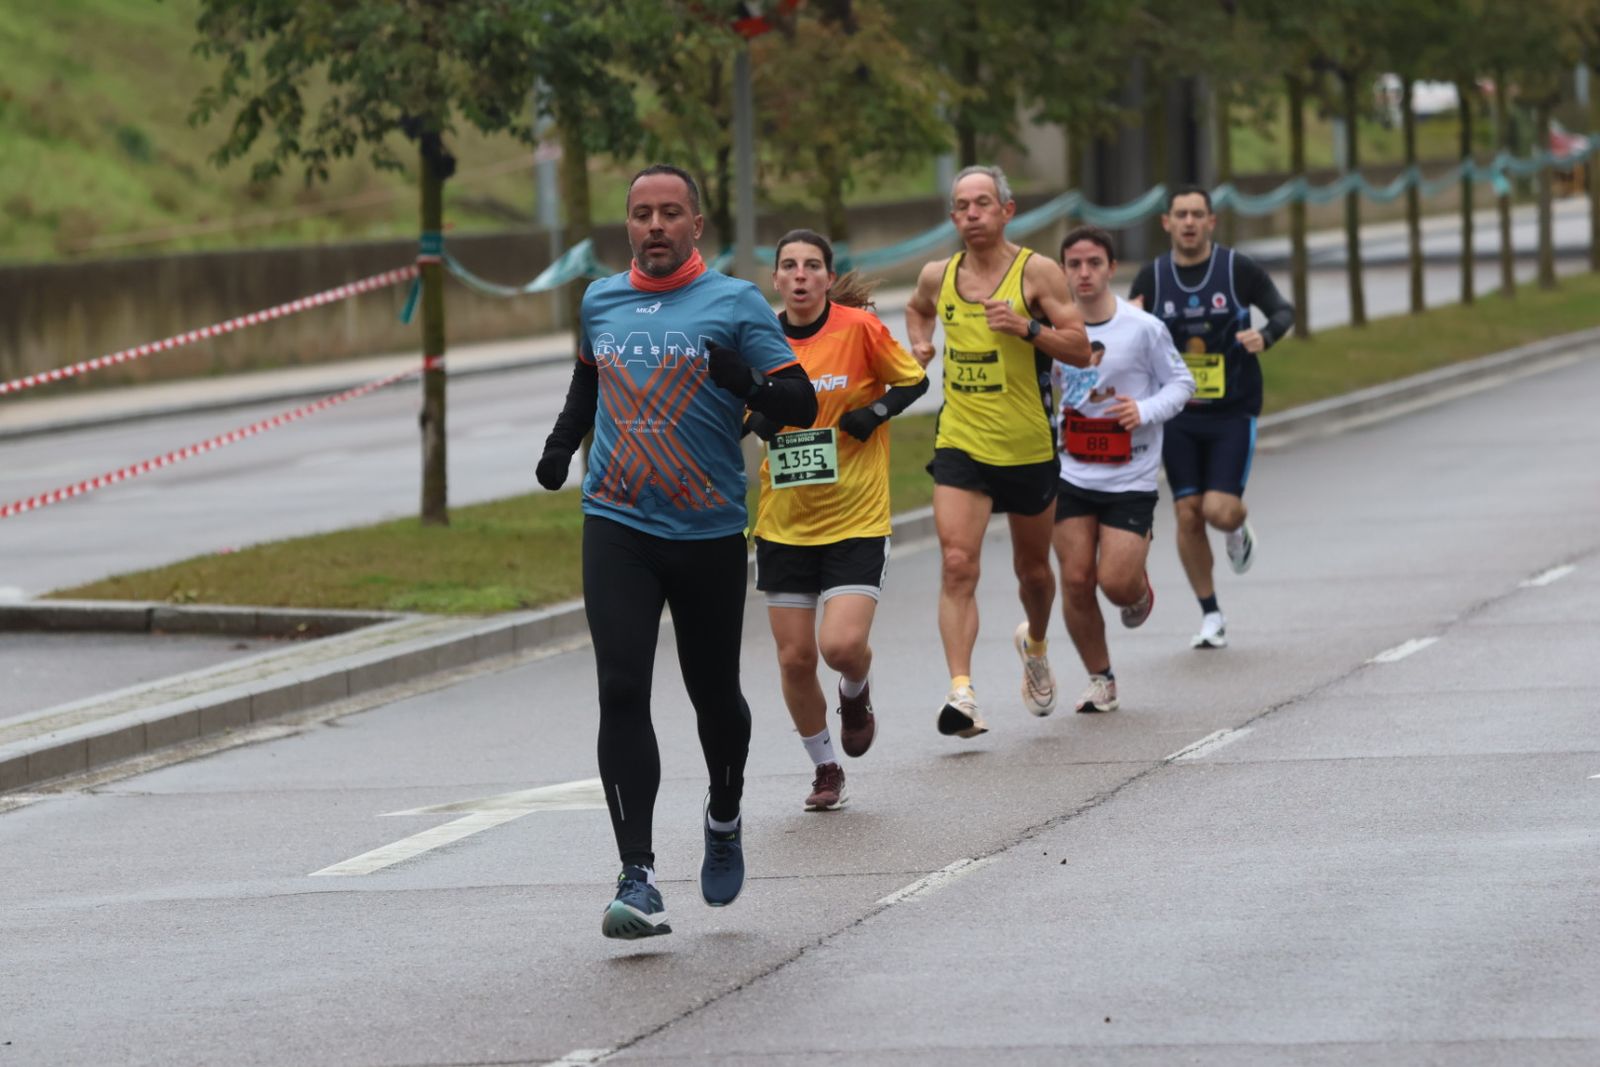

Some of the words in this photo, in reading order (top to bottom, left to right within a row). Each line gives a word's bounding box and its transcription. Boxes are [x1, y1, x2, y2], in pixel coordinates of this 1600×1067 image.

[594, 332, 712, 372] SAN
[957, 366, 987, 382] 214
[1087, 436, 1108, 451] 88
[778, 448, 825, 469] 1355
